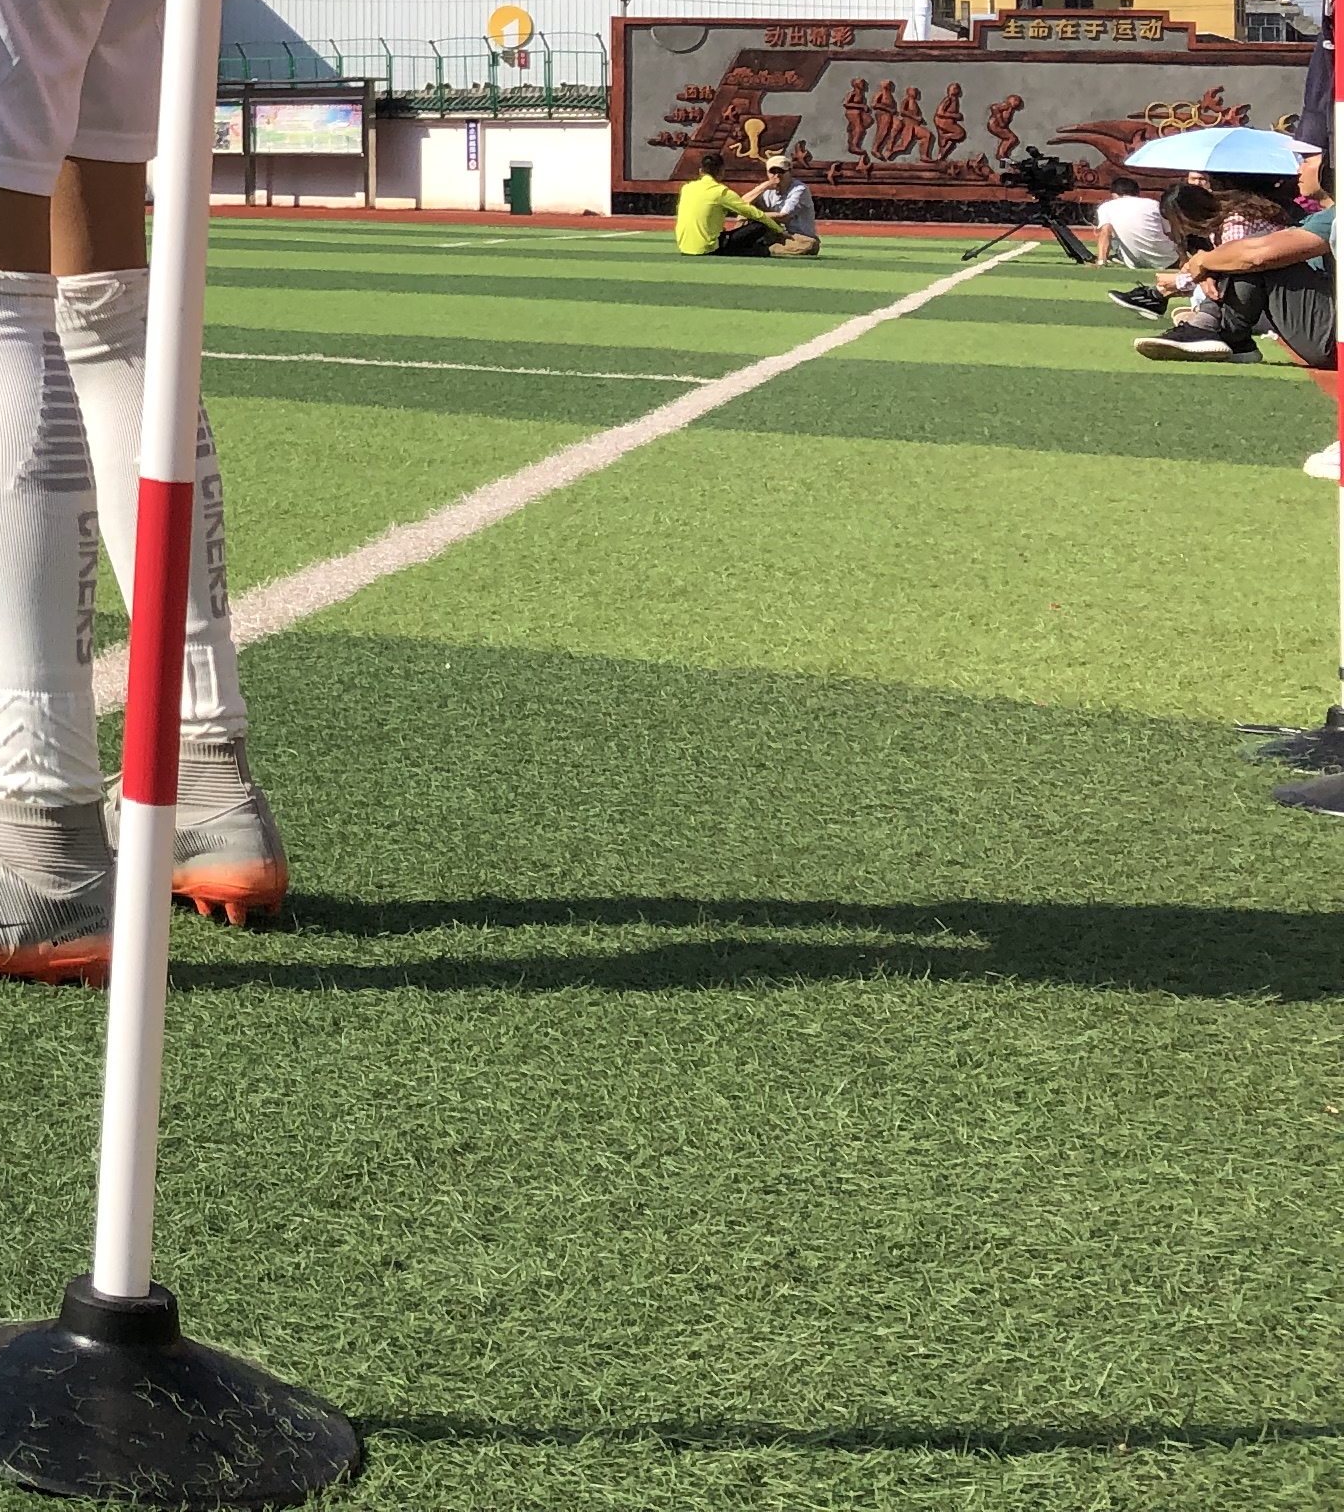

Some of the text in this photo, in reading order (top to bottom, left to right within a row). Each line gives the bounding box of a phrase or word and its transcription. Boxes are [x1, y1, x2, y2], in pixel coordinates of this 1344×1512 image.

[765, 26, 854, 47] 动出精彩
[1003, 18, 1163, 39] 生命在于运动
